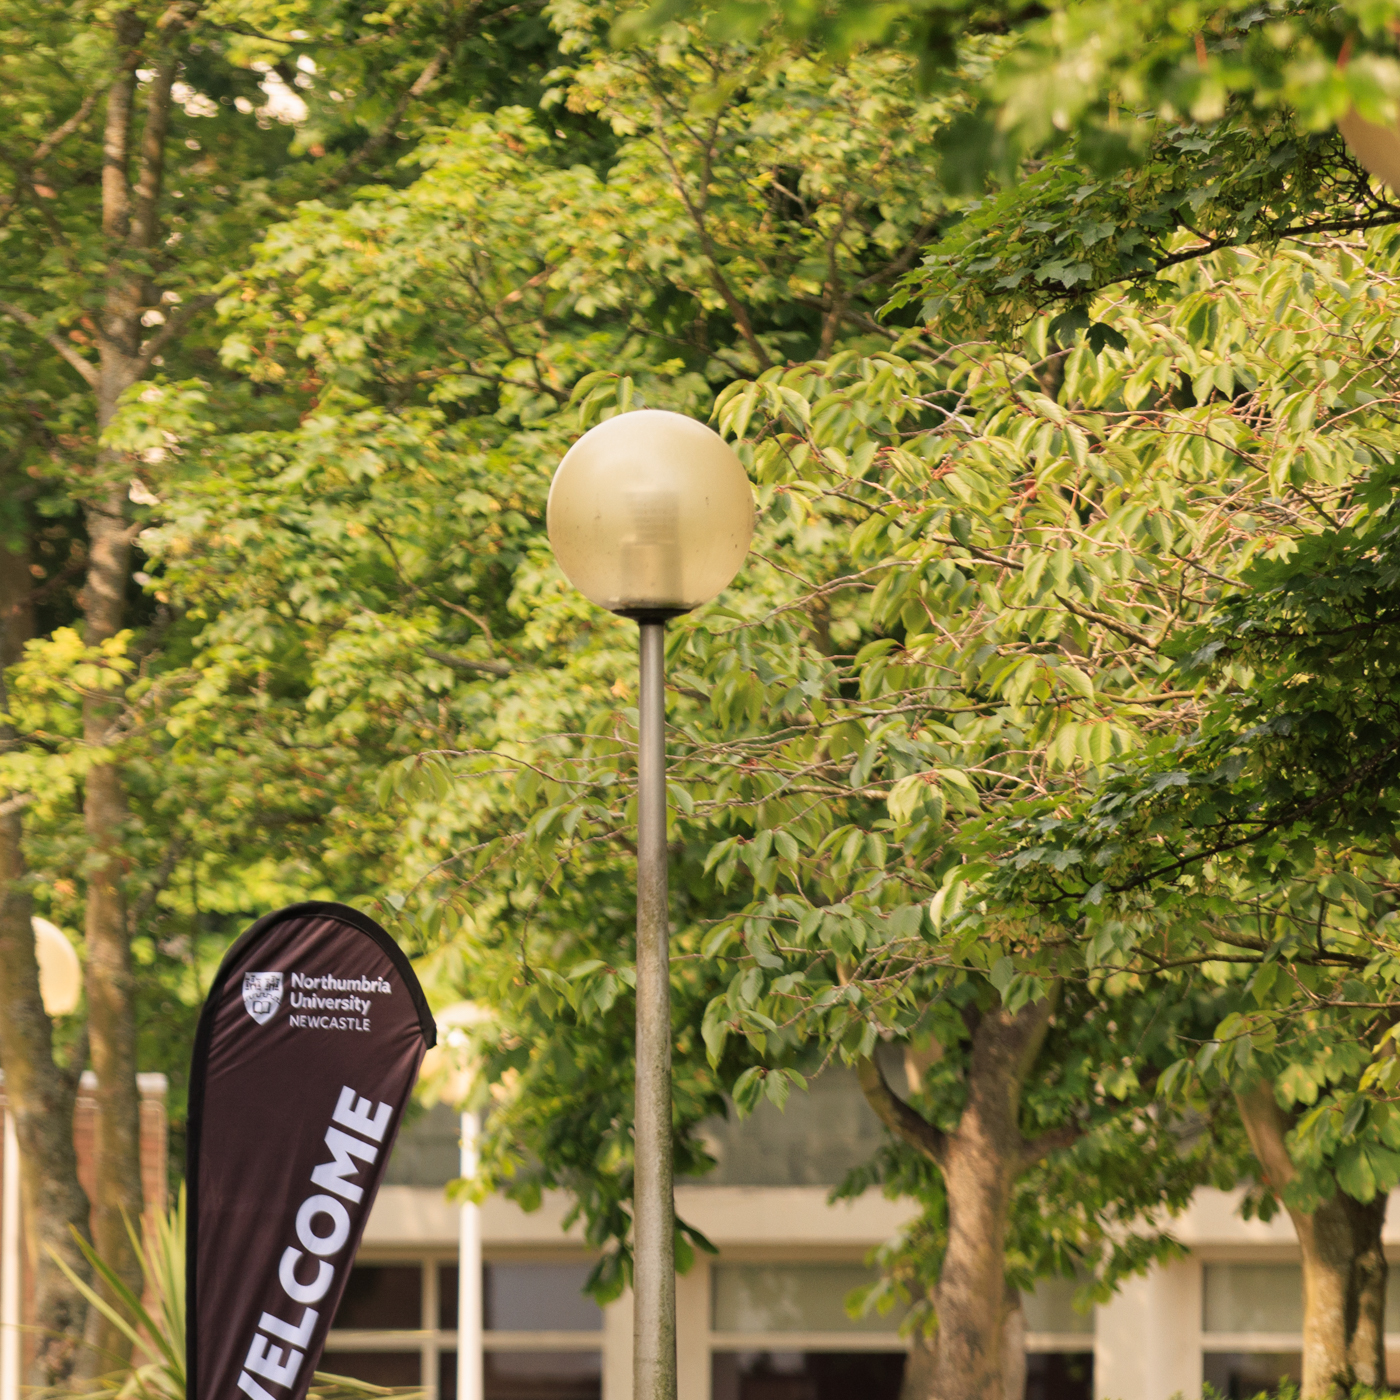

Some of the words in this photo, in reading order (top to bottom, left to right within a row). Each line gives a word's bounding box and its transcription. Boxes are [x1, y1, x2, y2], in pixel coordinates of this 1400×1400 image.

[291, 972, 392, 994] Northumbria
[290, 991, 371, 1016] University
[289, 1014, 371, 1032] NEWCASTLE
